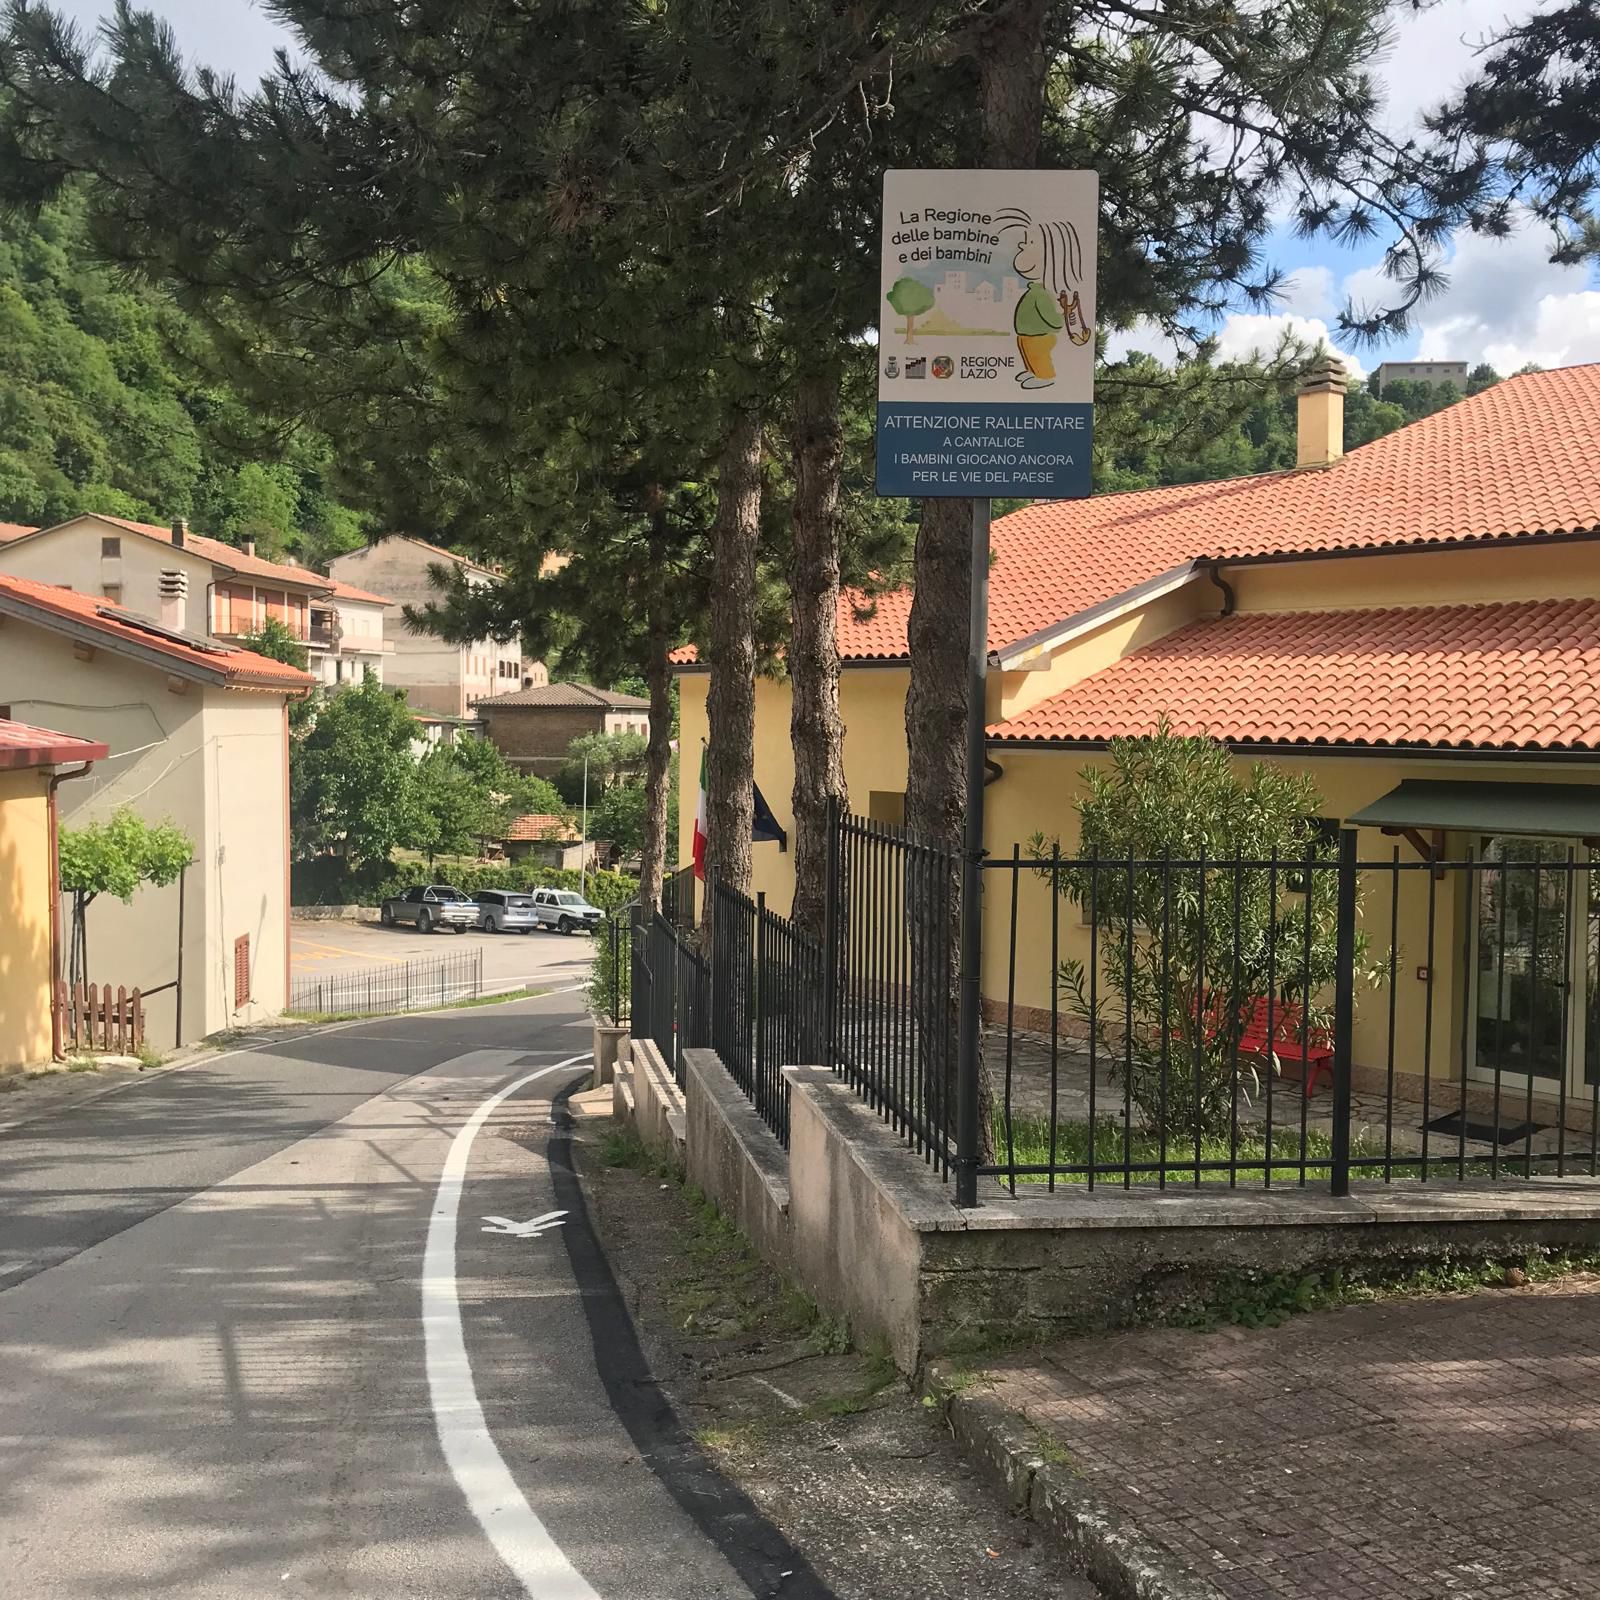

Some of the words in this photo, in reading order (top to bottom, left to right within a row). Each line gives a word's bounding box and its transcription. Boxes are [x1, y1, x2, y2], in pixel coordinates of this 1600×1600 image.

[899, 211, 920, 225] La
[924, 208, 992, 224] Regione
[891, 228, 930, 245] delle
[933, 227, 1000, 246] bambine
[898, 253, 908, 264] e
[911, 246, 932, 261] dei
[935, 246, 993, 264] bambini
[960, 356, 1015, 368] REGIONE
[960, 368, 998, 379] LAZIO
[884, 415, 981, 429] ATTENZIONE
[985, 416, 1085, 430] RALLENTARE
[943, 436, 952, 447] A
[954, 437, 1025, 448] CANTALICE
[894, 454, 898, 465] I
[901, 454, 953, 465] BAMBINI
[956, 454, 1017, 466] GIOCANO
[1018, 455, 1074, 466] ANCORA
[912, 471, 939, 482] PER
[942, 472, 958, 482] LE
[961, 472, 981, 483] VIE
[985, 472, 1010, 483] DEL
[1013, 472, 1055, 483] PAESE
